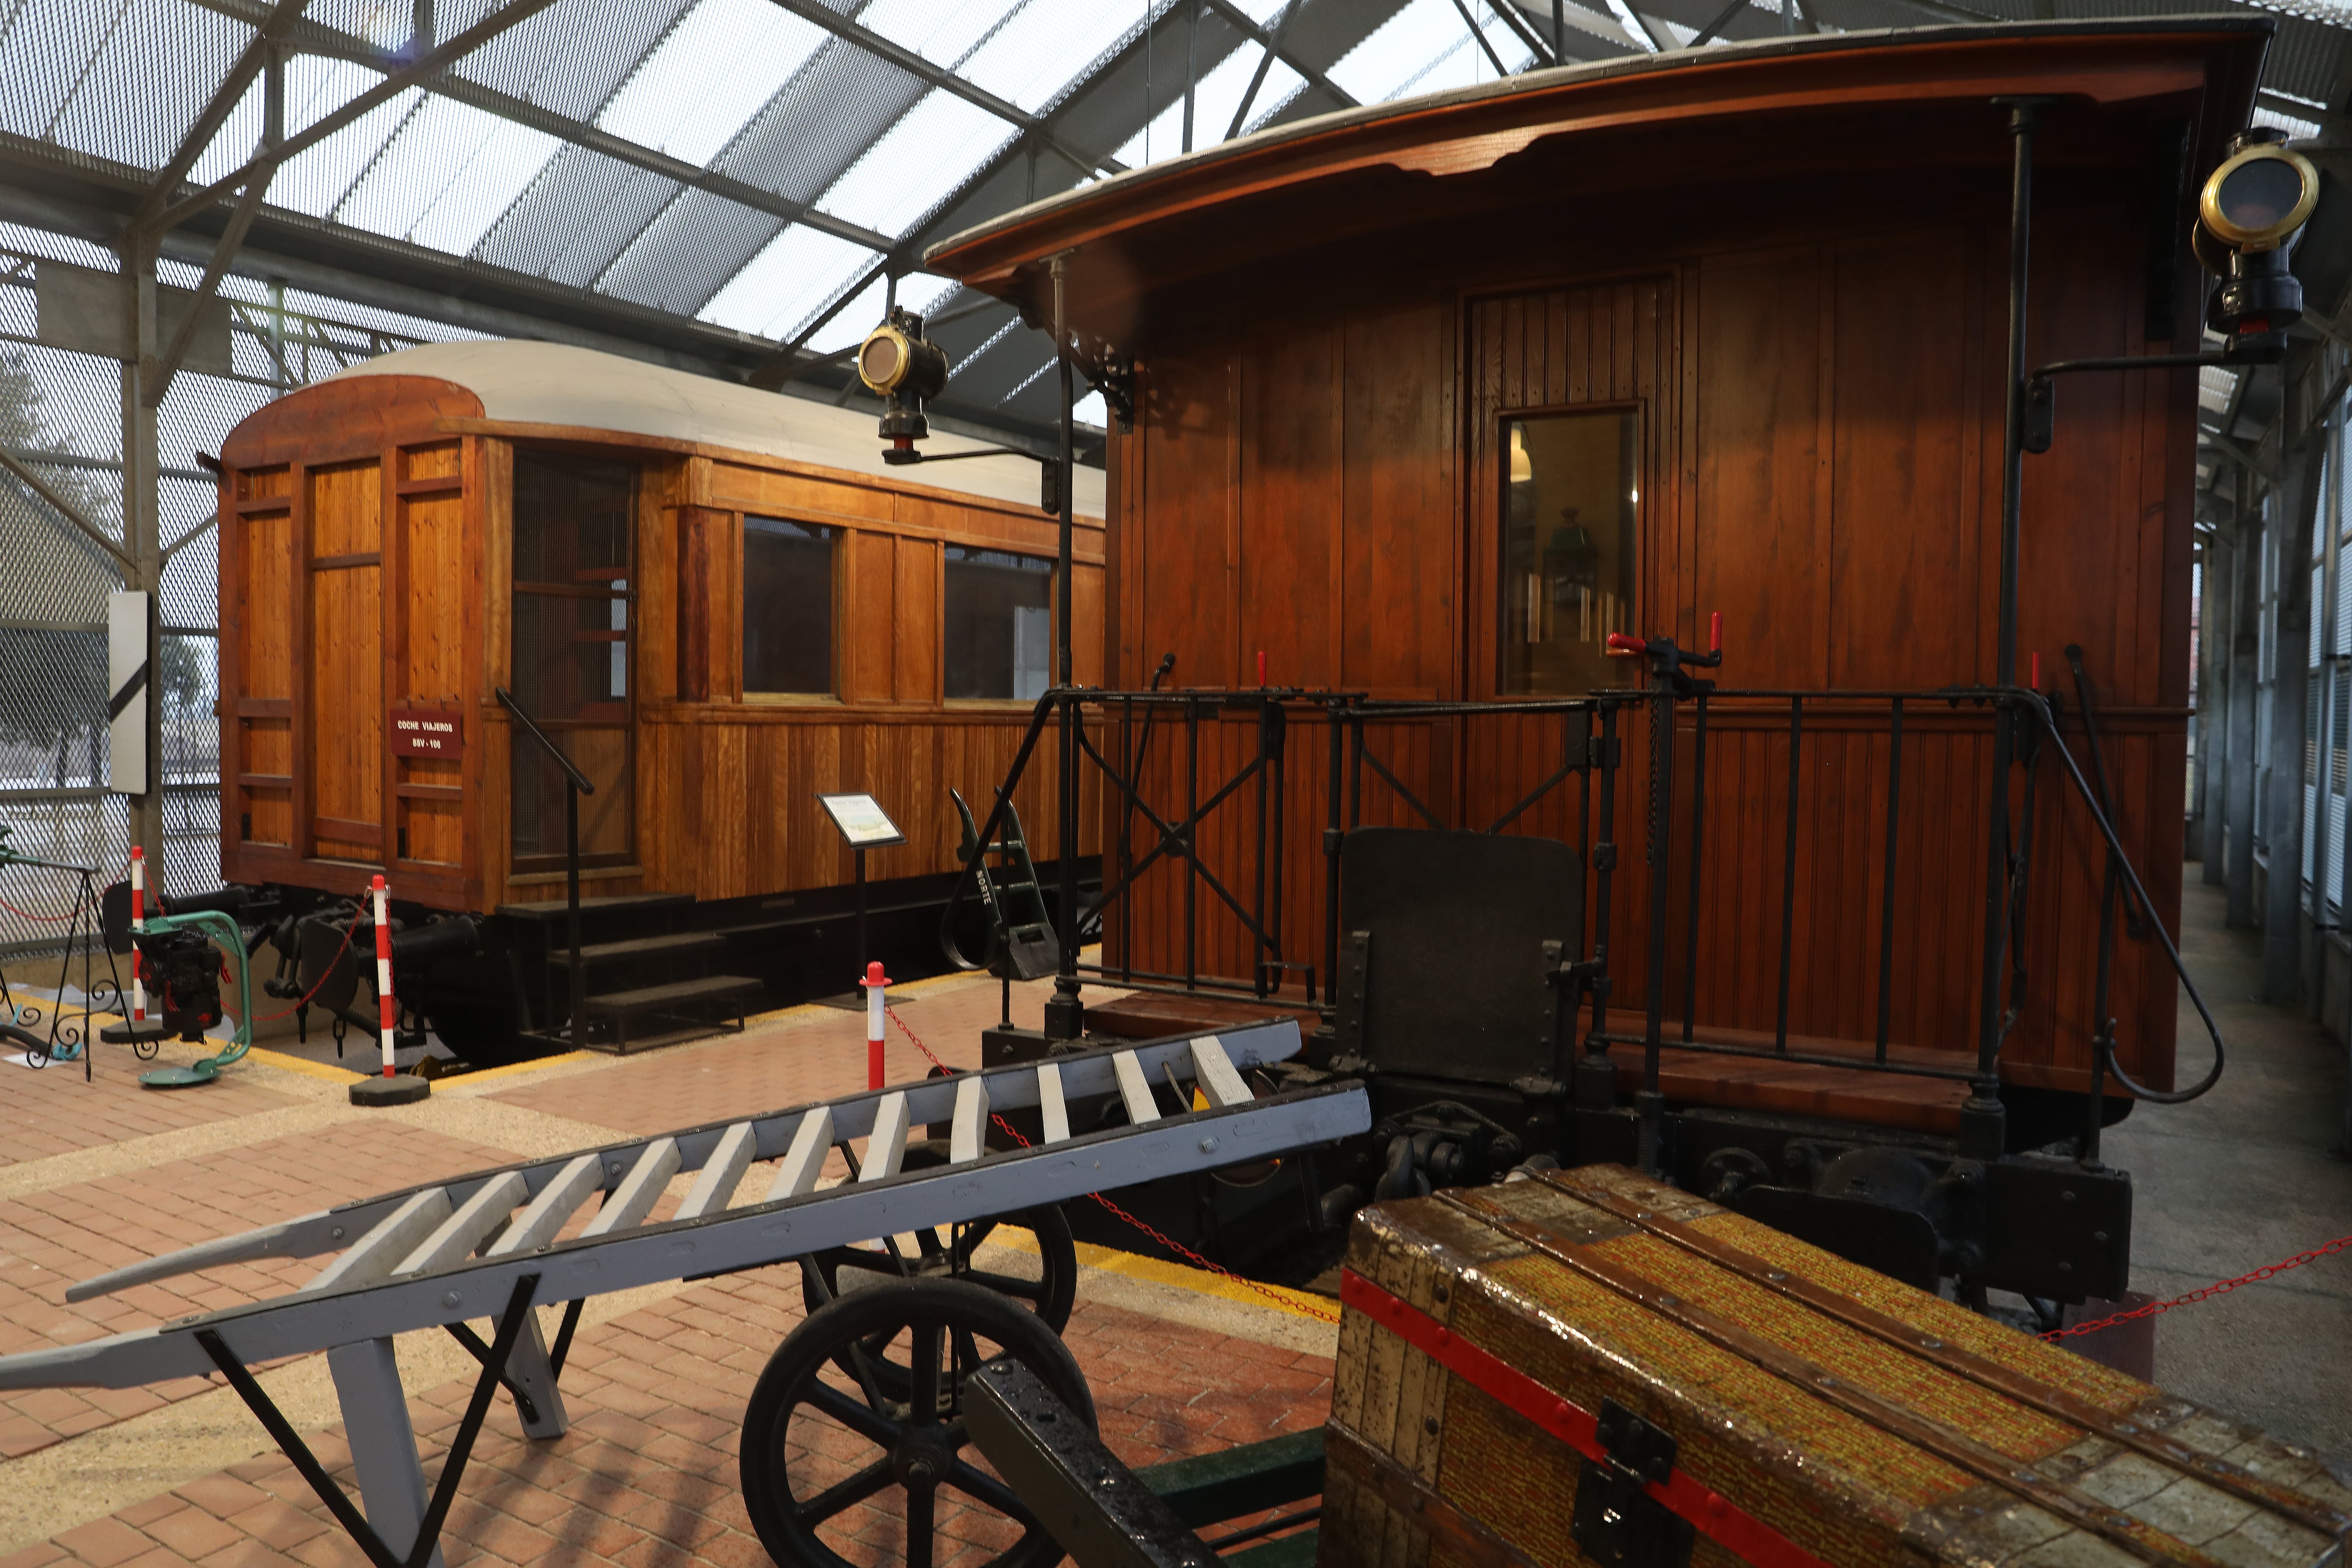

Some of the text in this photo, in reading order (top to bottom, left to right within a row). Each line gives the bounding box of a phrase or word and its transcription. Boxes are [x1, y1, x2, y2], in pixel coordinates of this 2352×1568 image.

[397, 720, 453, 732] COCHE VIAJEROS
[976, 869, 992, 905] NORTE
